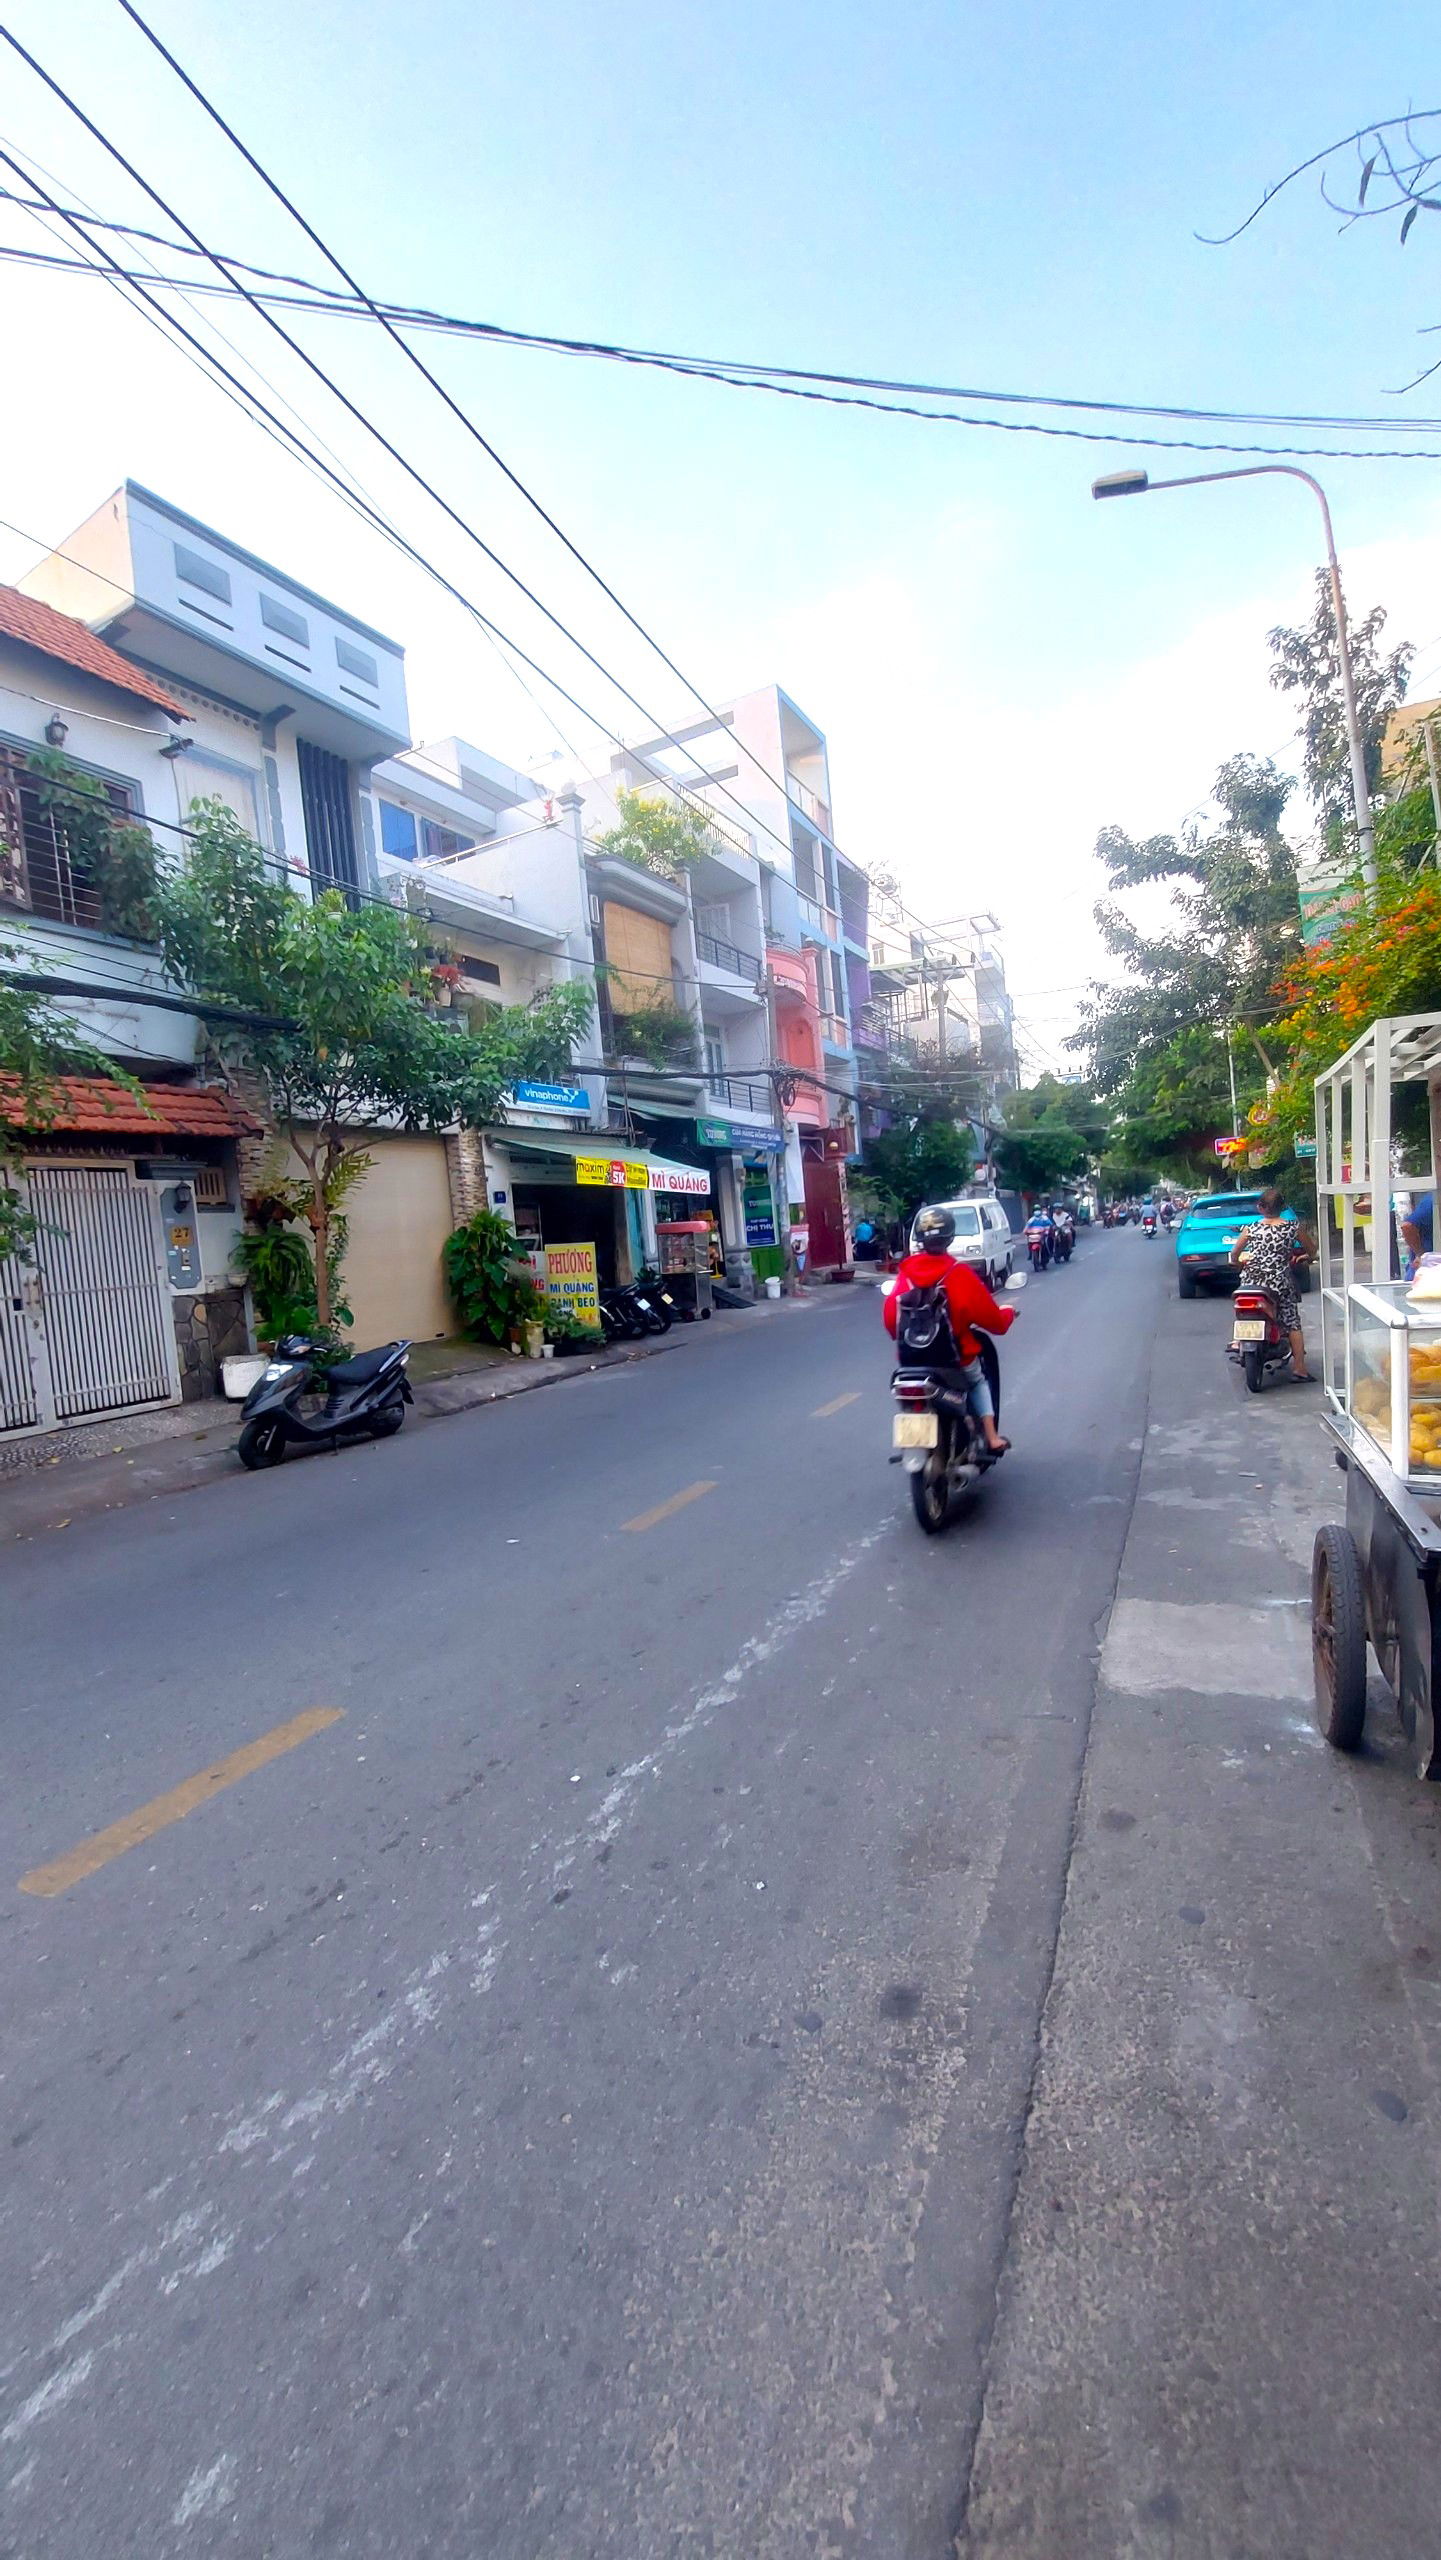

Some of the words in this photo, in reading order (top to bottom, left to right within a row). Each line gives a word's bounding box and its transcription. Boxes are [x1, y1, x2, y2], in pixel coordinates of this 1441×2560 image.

[524, 1088, 568, 1103] vinaphone
[576, 1162, 604, 1175] maxim
[652, 1170, 665, 1189] MÌ
[669, 1171, 707, 1192] QUẢNG
[174, 1226, 189, 1238] 27
[548, 1249, 592, 1276] PHƯỢNG
[550, 1281, 561, 1293] MÌ
[563, 1279, 594, 1294] QUẢNG
